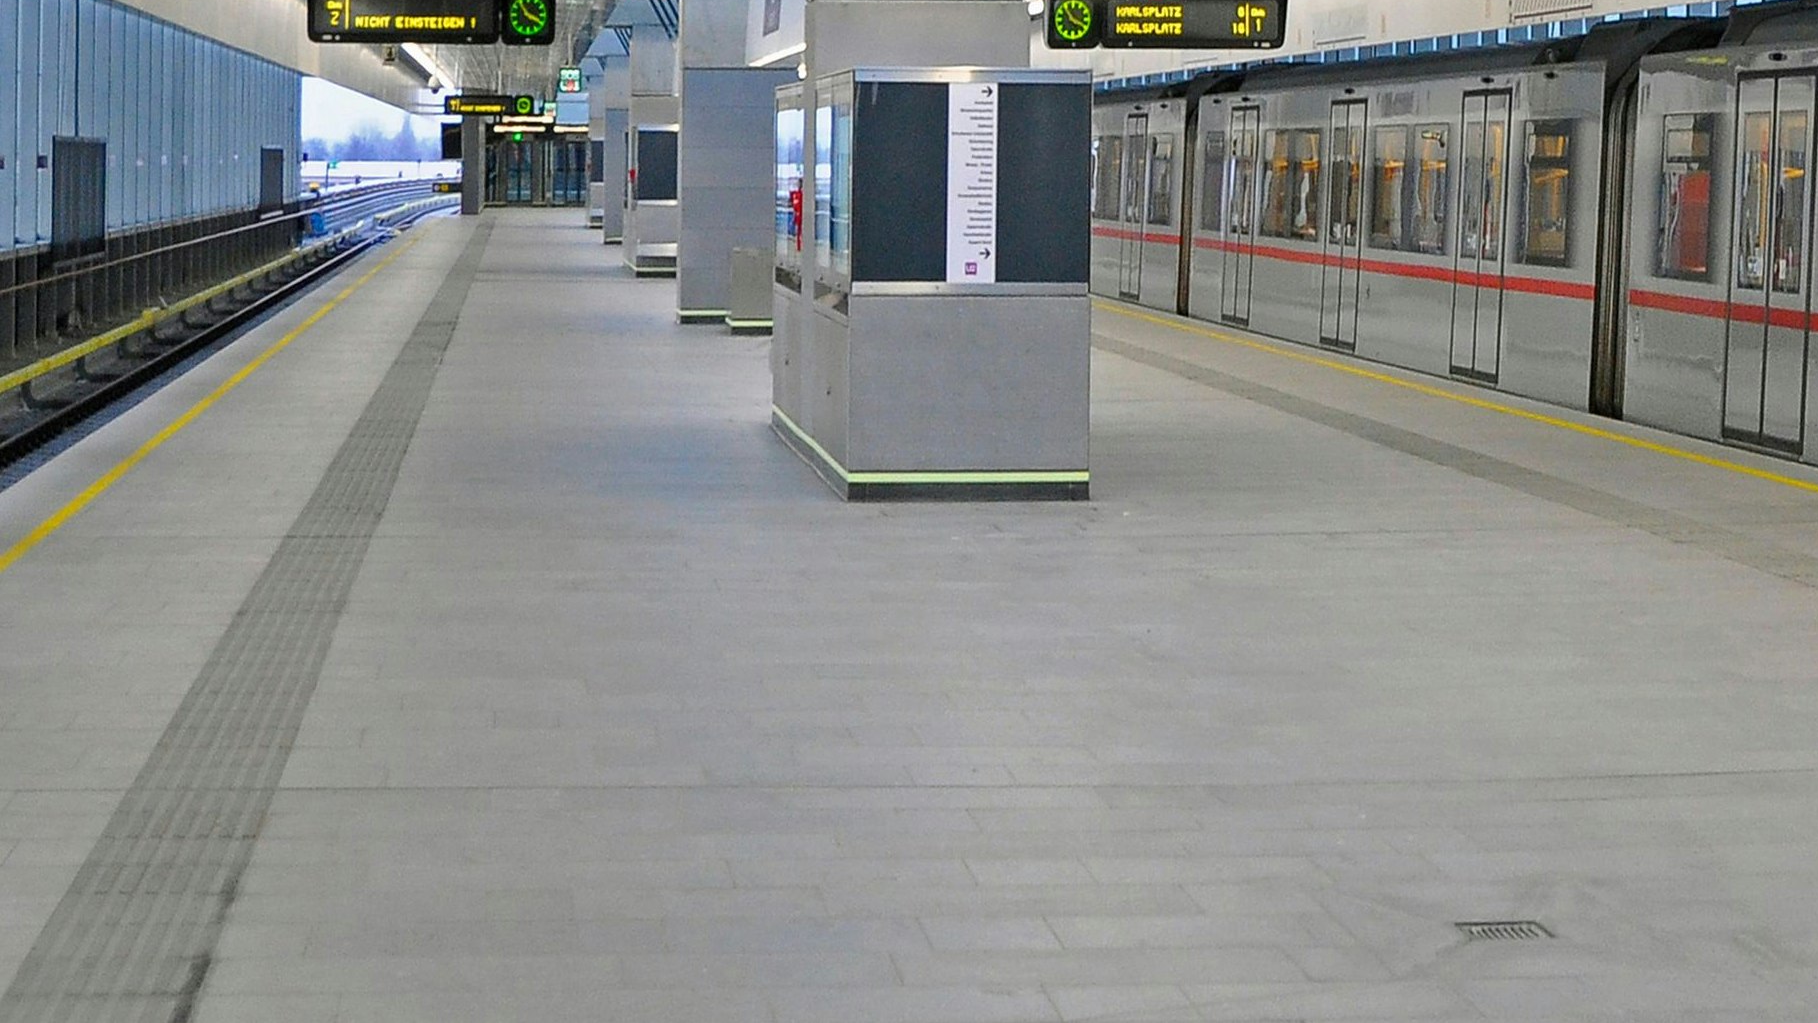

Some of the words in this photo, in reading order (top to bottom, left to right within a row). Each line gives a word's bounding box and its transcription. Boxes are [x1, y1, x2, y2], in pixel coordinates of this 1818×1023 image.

[330, 11, 340, 26] 2
[1116, 6, 1182, 18] KARLSPLATZ
[355, 16, 391, 28] NICHT
[395, 16, 465, 29] EINSTEIGEN
[1116, 22, 1182, 35] KARLSPLATZ
